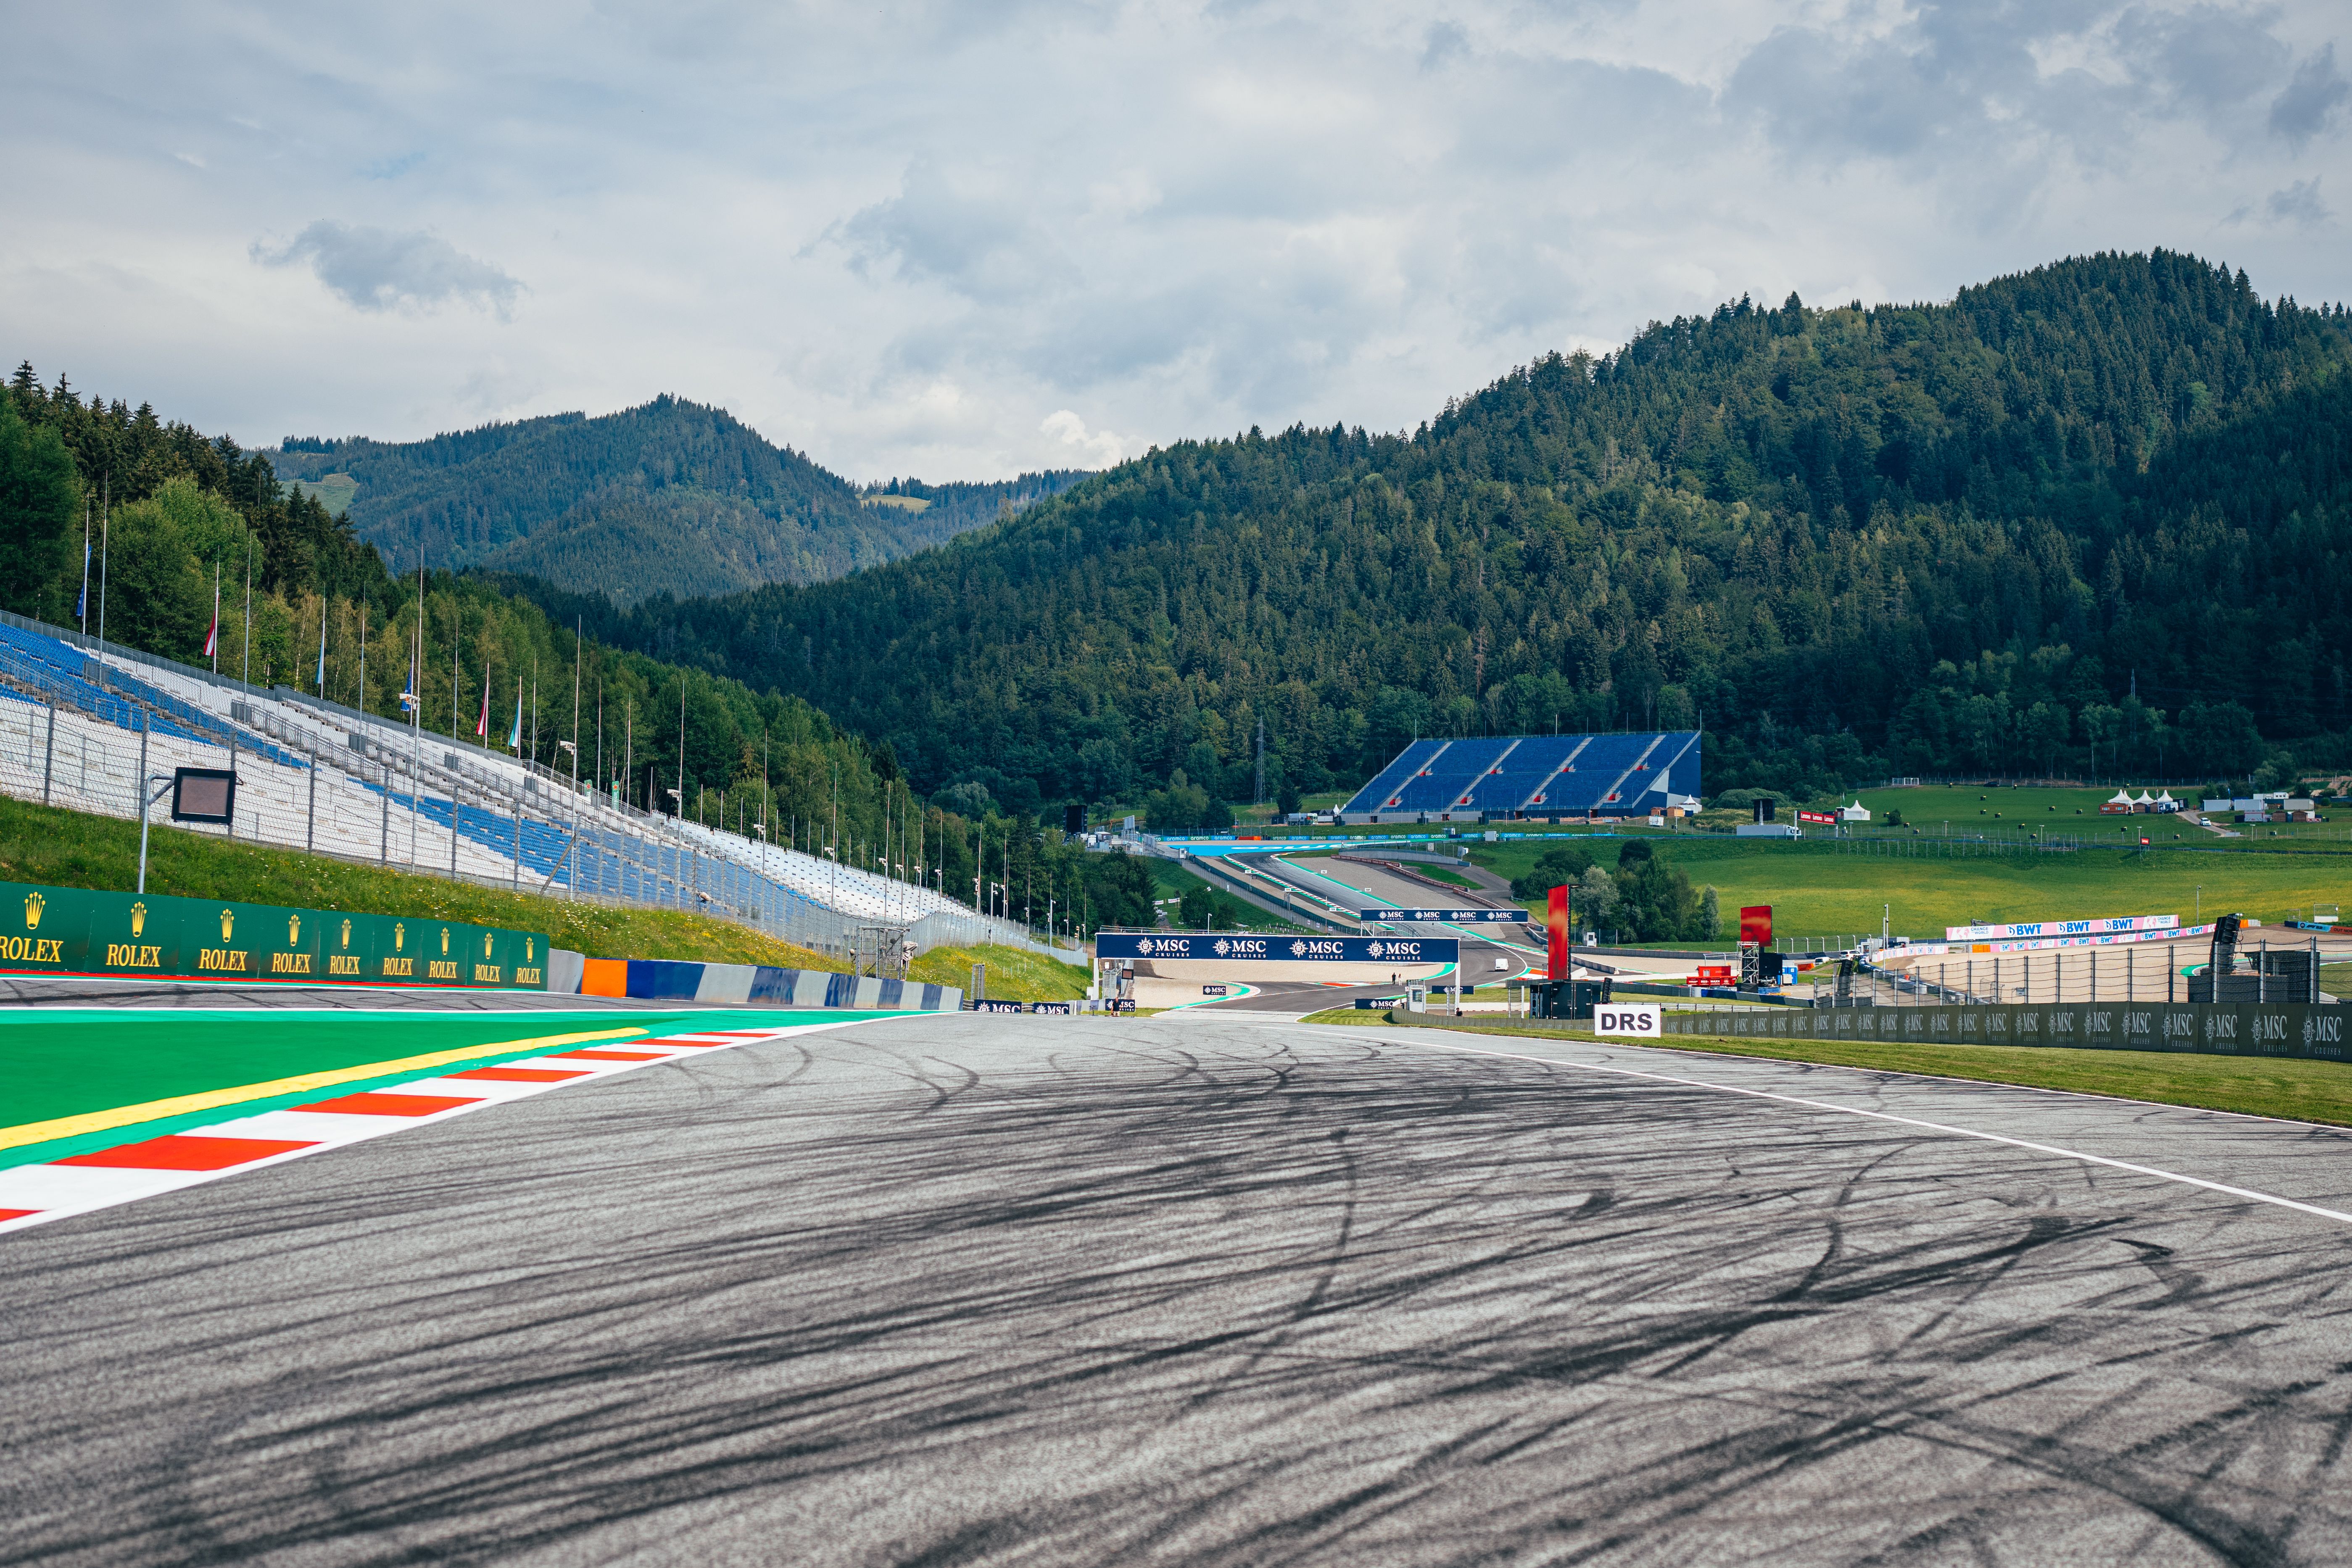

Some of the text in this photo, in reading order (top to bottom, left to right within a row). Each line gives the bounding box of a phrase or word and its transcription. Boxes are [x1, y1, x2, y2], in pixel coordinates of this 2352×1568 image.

[2017, 924, 2041, 935] BWT
[2067, 922, 2090, 932] BWT
[2112, 919, 2133, 930] BWT
[1156, 939, 1189, 951] MSC
[1232, 940, 1266, 952] MSC
[1309, 941, 1343, 953] MSC
[1386, 943, 1420, 954] MSC
[106, 944, 161, 967] ROLEX
[198, 949, 248, 971] ROLEX
[272, 953, 311, 973] ROLEX
[330, 956, 360, 975] ROLEX
[383, 957, 413, 975] ROLEX
[429, 961, 457, 979] ROLEX
[475, 964, 500, 982] ROLEX
[516, 967, 541, 984] ROLEX
[992, 1004, 1020, 1013] MSC
[1601, 1013, 1652, 1030] DRS
[1720, 1019, 1729, 1032] MSC
[1738, 1018, 1748, 1032] MSC
[1758, 1018, 1767, 1031] MSC
[1777, 1017, 1787, 1031] MSC
[1797, 1016, 1807, 1030] MSC
[1819, 1015, 1829, 1030] MSC
[1840, 1015, 1851, 1029] MSC
[1863, 1015, 1874, 1030] MSC
[1886, 1015, 1898, 1030] MSC
[1911, 1015, 1923, 1030] MSC
[1937, 1014, 1949, 1031] MSC
[1964, 1014, 1977, 1031] MSC
[1992, 1013, 2007, 1031] MSC
[2023, 1013, 2038, 1032] MSC
[2057, 1012, 2074, 1032] MSC
[2093, 1012, 2111, 1032] MSC
[2132, 1012, 2151, 1033] MSC
[2173, 1014, 2193, 1036] MSC
[2216, 1015, 2237, 1038] MSC
[2264, 1015, 2287, 1040] MSC
[2316, 1016, 2342, 1042] MSC
[2315, 1047, 2341, 1055] CRUISES
